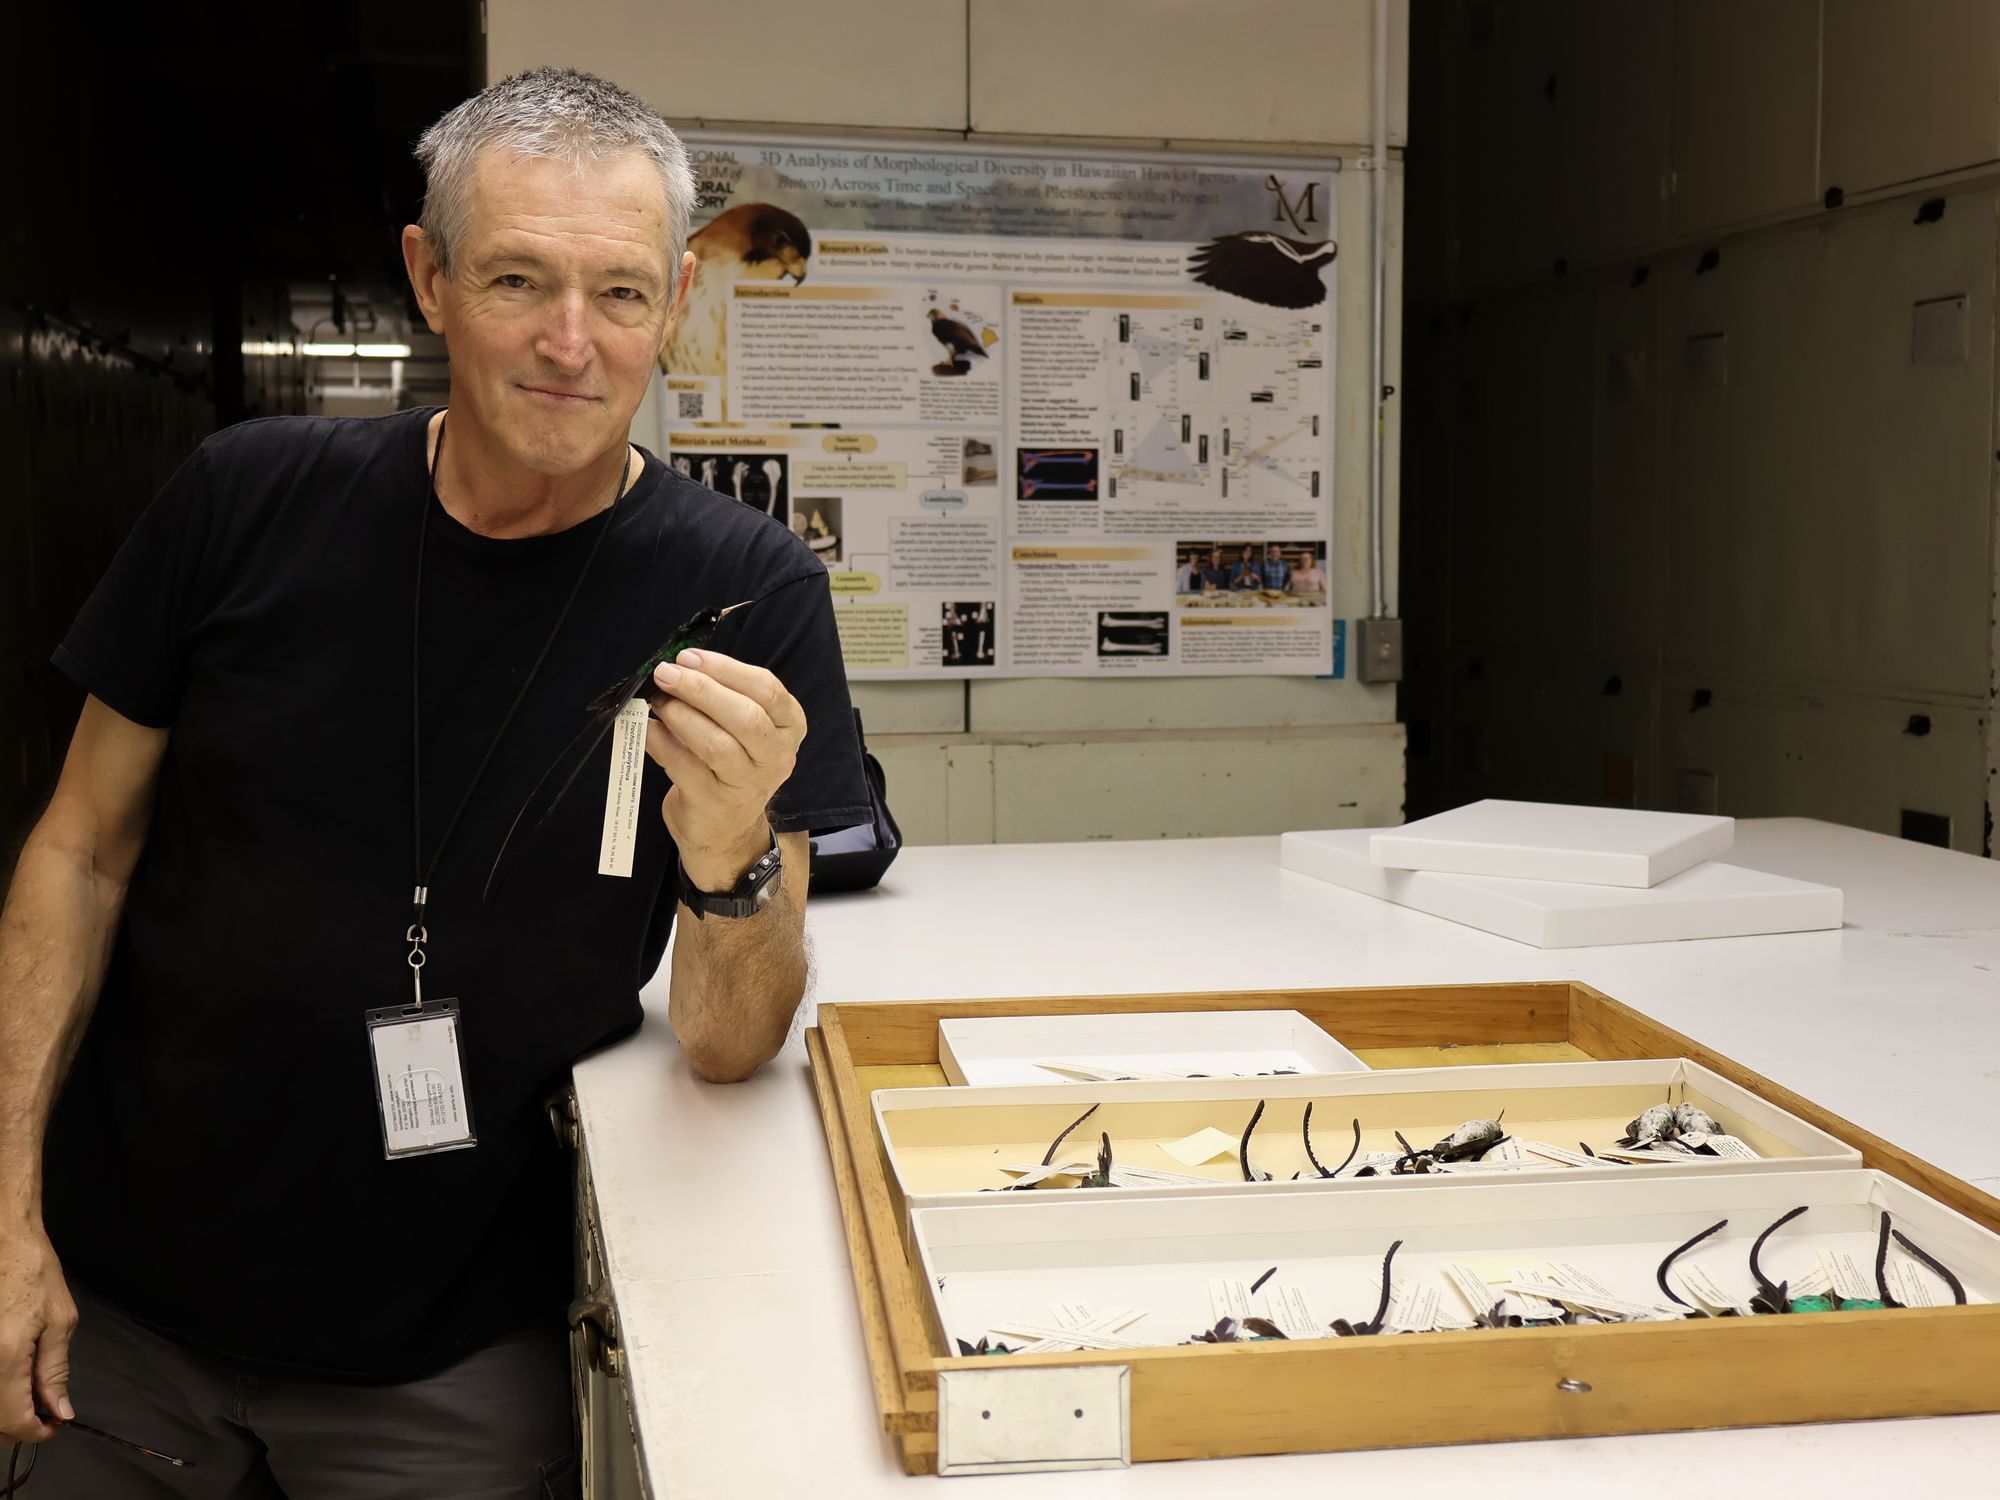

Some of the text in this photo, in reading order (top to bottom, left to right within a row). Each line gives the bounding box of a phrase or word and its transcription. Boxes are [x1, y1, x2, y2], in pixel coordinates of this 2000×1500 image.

[759, 151, 782, 166] 3D
[785, 152, 850, 172] Analysis
[853, 155, 869, 169] of
[871, 156, 980, 177] Morphological
[983, 160, 1049, 180] Diversity
[1052, 163, 1067, 177] in
[1069, 163, 1137, 179] Hawaiian
[1140, 166, 1189, 181] Hawks
[830, 177, 882, 192] Across
[885, 179, 923, 194] Time
[925, 180, 952, 195] and
[1044, 184, 1125, 201] Pleistocene
[1127, 188, 1142, 201] to
[1169, 189, 1219, 204] Present
[906, 248, 928, 256] better
[929, 248, 972, 257] understand
[972, 250, 989, 258] how
[829, 258, 869, 267] determine
[870, 260, 888, 268] how
[889, 262, 912, 270] many
[952, 262, 965, 270] the
[735, 288, 790, 298] Introduction
[670, 436, 766, 447] Materials and Methods
[1013, 549, 1058, 558] Conclusion
[623, 721, 636, 780] Trochilus polytmus
